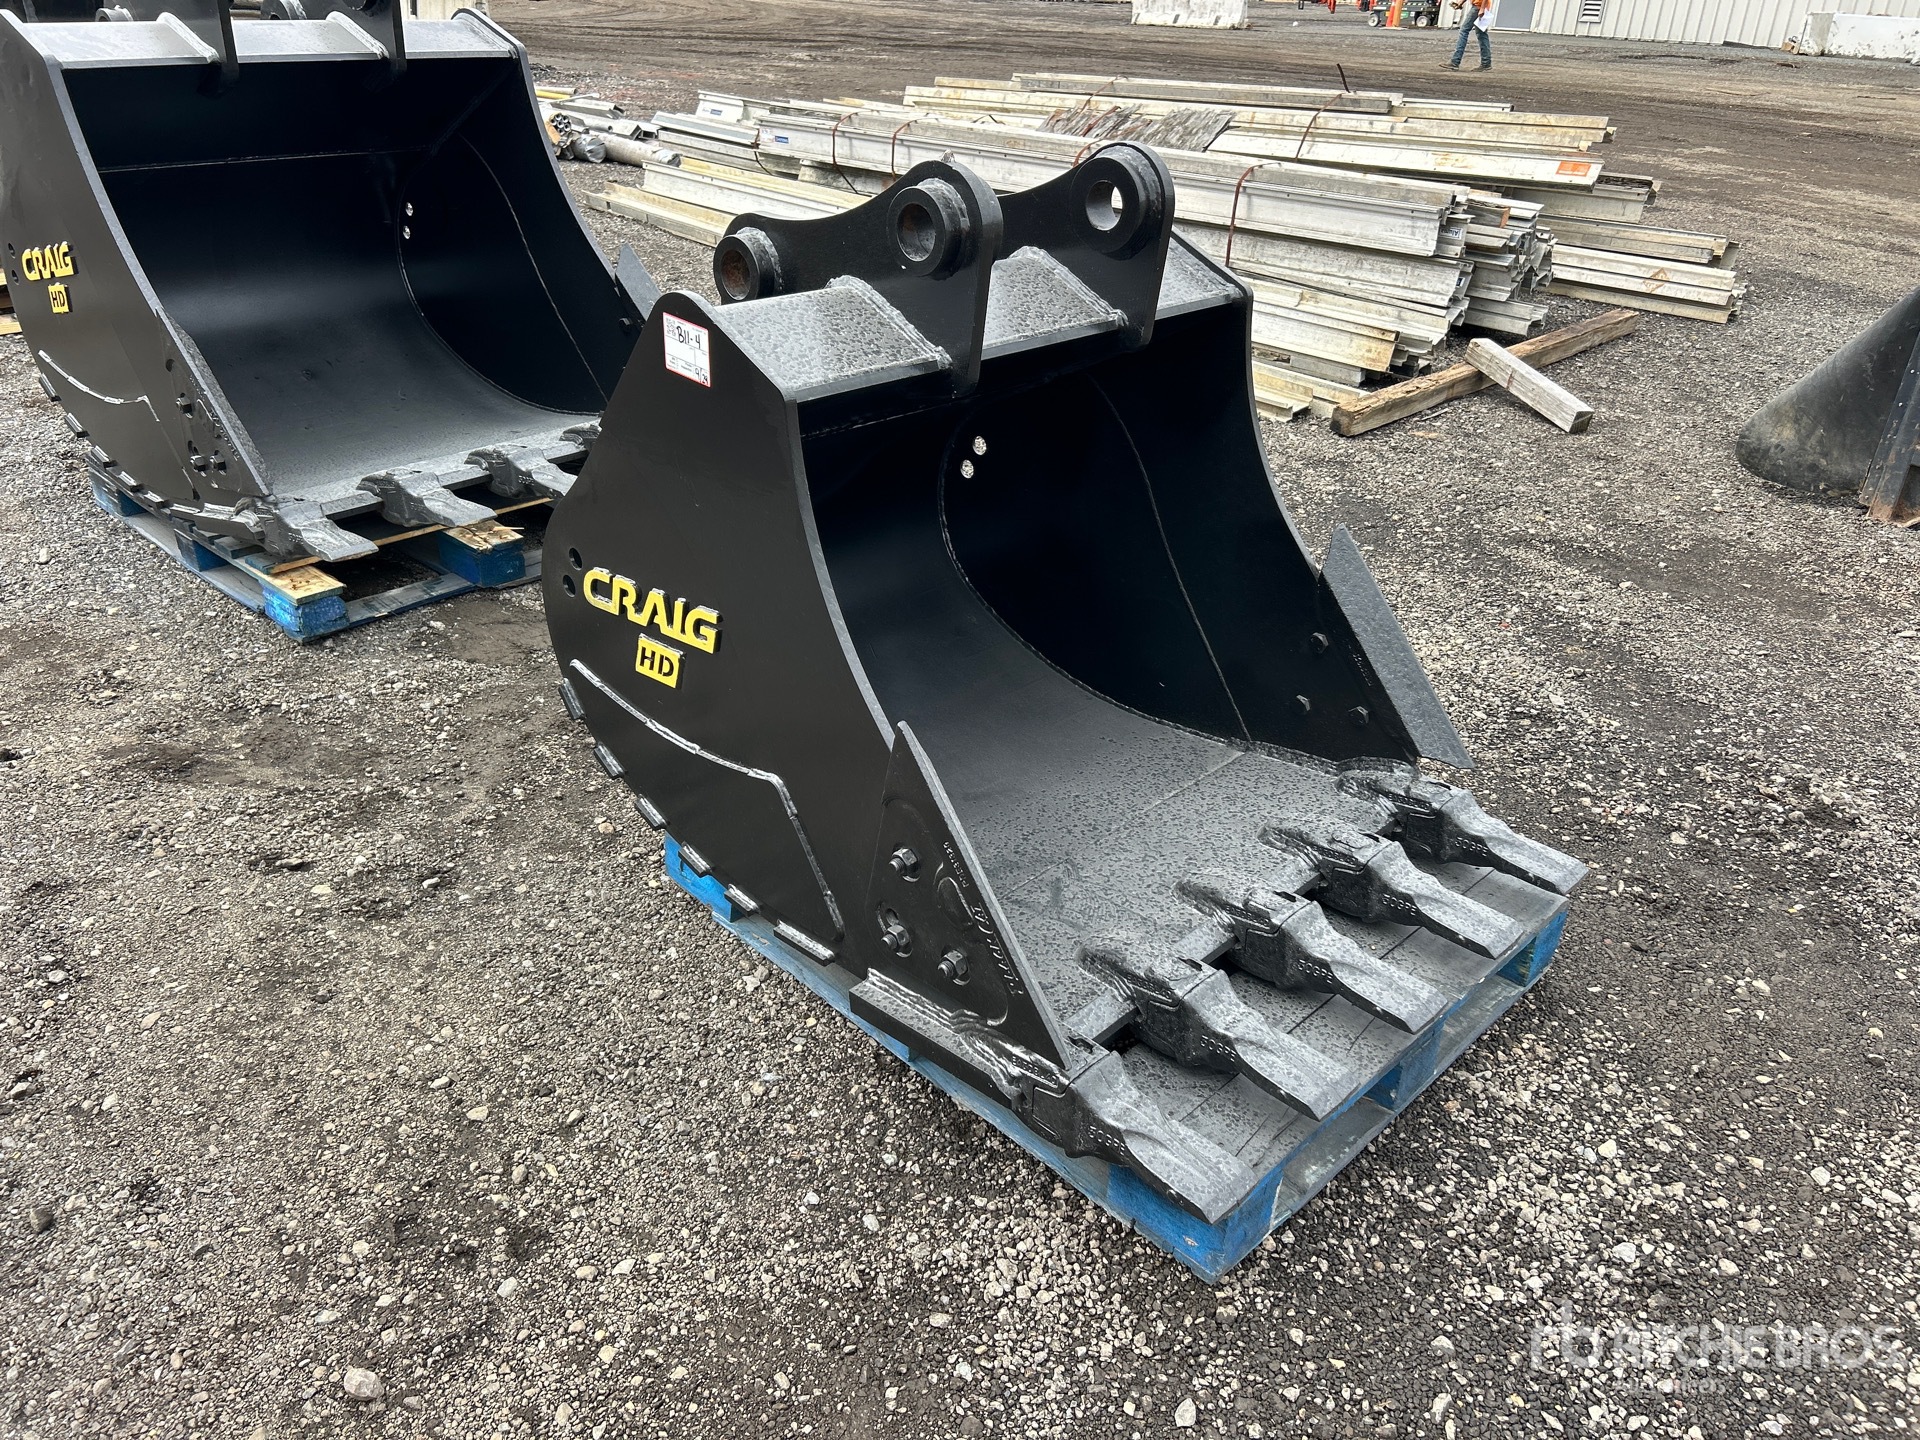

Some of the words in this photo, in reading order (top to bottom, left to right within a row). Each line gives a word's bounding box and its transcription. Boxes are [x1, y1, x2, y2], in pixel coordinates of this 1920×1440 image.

[21, 241, 74, 281] CRAIG
[50, 291, 66, 308] HD
[583, 567, 720, 654] CRAIG
[639, 646, 675, 677] HD
